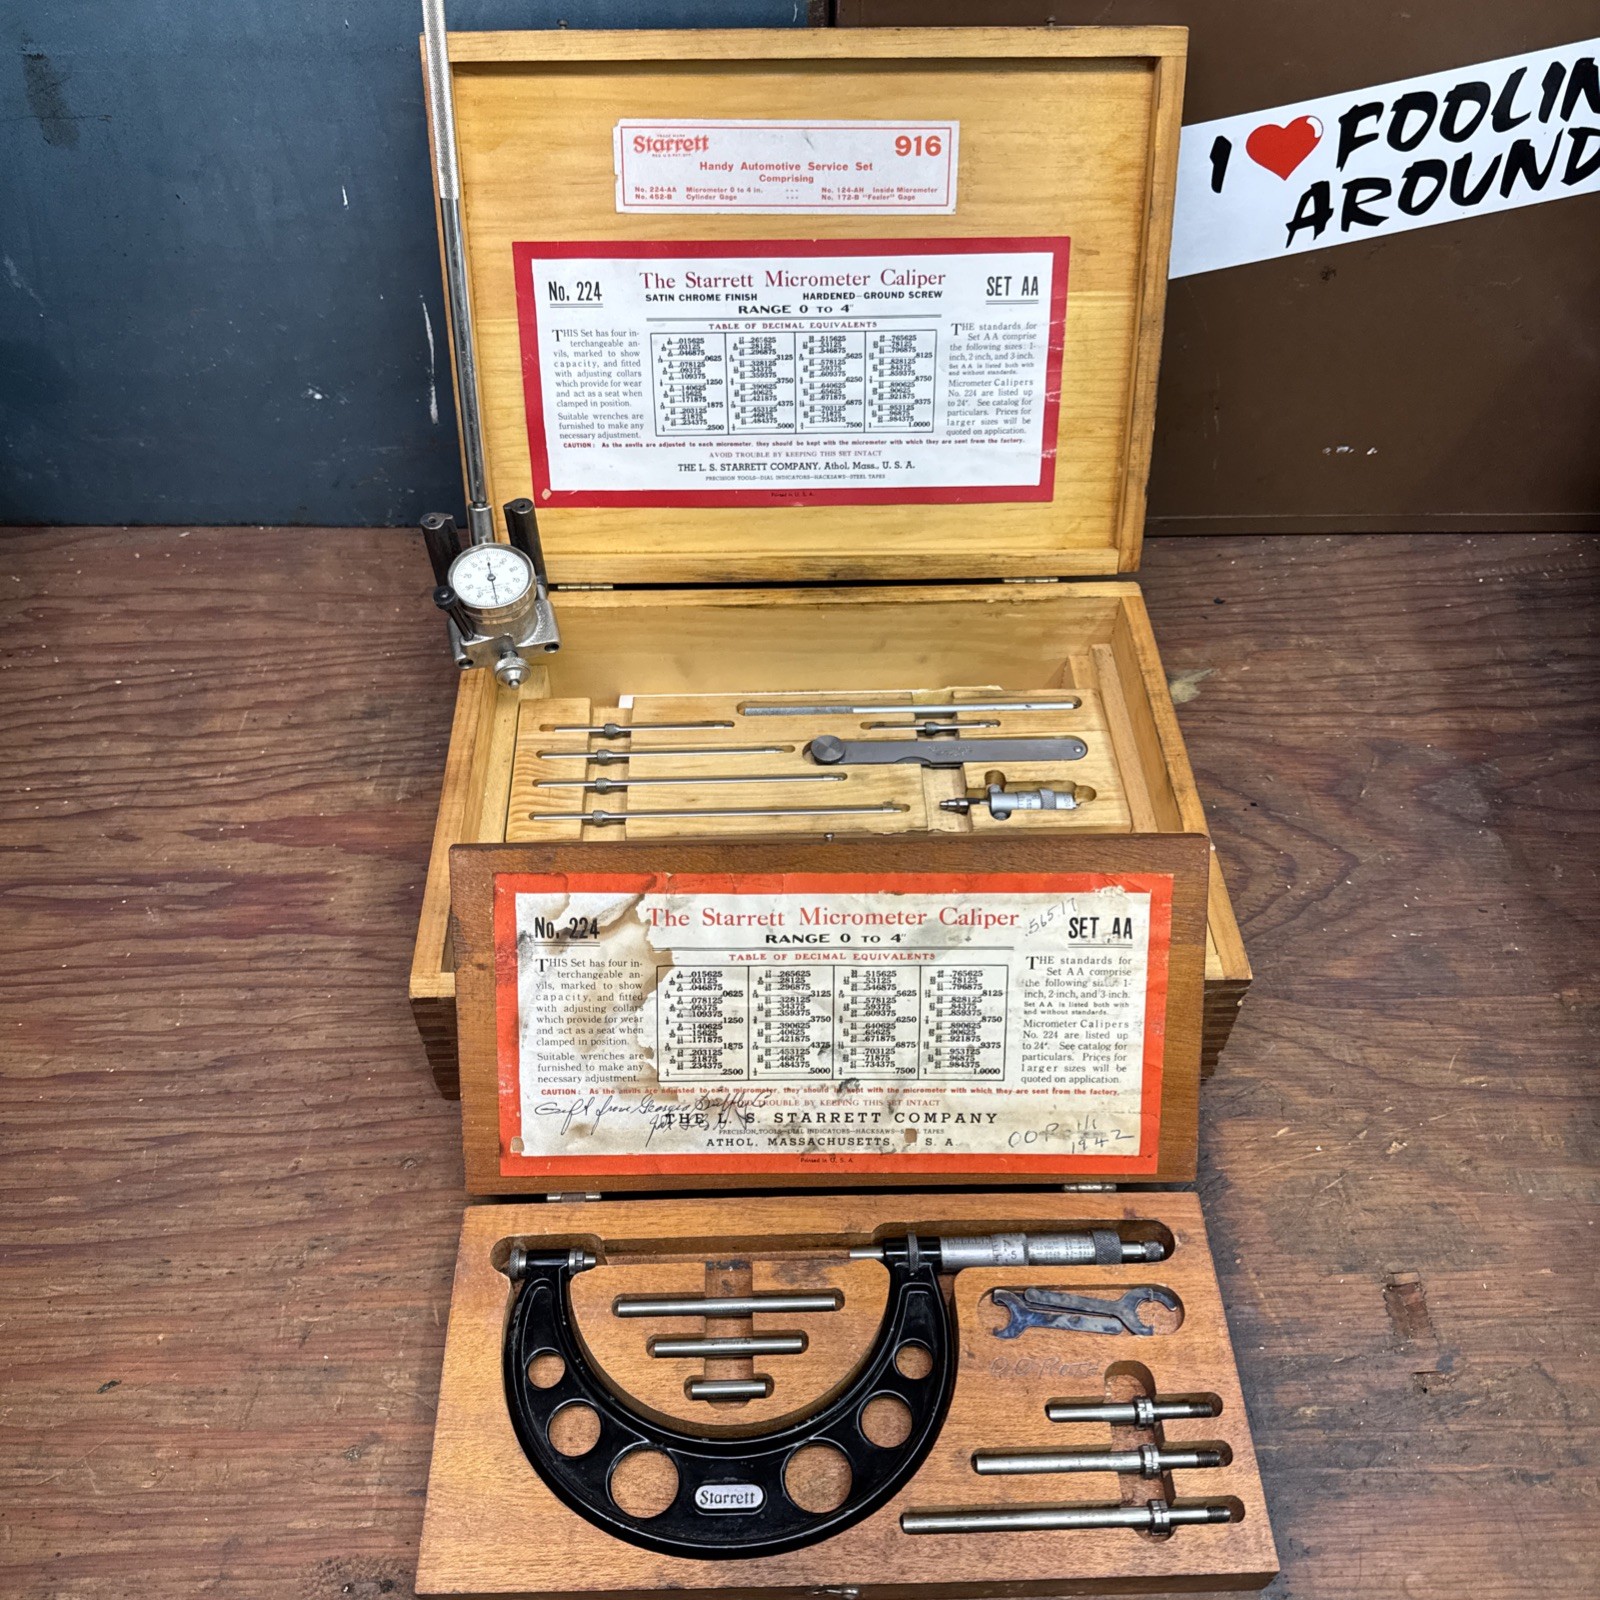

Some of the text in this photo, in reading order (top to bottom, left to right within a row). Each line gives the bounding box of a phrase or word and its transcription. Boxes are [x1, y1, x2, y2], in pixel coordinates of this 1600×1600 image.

[633, 134, 709, 153] Starrett
[895, 135, 942, 156] 916
[700, 161, 872, 172] Handy Automotive Service Set
[1210, 135, 1232, 194] I
[758, 174, 813, 183] Comprising
[1286, 127, 1600, 248] AROUND
[640, 268, 946, 289] The Starrett Micrometer Caliper
[548, 281, 602, 301] No. 224
[986, 275, 1038, 296] SET AA
[738, 304, 790, 314] RANGE
[799, 304, 808, 313] 0
[552, 329, 578, 342] THIS
[581, 328, 592, 336] Set
[596, 328, 609, 336] has
[611, 328, 626, 336] four
[570, 339, 623, 349] terchangeable
[554, 349, 640, 359] vils, marked to show
[554, 359, 640, 369] capacity, and fitted
[555, 369, 641, 379] with adjusting collars
[947, 406, 1031, 417] particulars. Prices for
[947, 416, 1030, 427] larger sizes will be
[946, 426, 971, 437] quoted
[984, 426, 1026, 437] application.
[678, 463, 696, 471] THE
[720, 462, 767, 471] STARRETT
[770, 462, 820, 470] COMPANY,
[882, 461, 891, 469] U.
[646, 907, 1018, 929] The Starrett Micrometer Caliper
[534, 917, 600, 939] No. 224
[1068, 917, 1132, 939] SET AA
[765, 933, 829, 943] RANGE
[840, 933, 850, 942] 0
[852, 952, 935, 960] EQUIVALENTS
[1026, 955, 1131, 970] THE standards for
[1024, 990, 1046, 1000] inch,
[1080, 990, 1097, 998] and
[1023, 1019, 1128, 1030] Micrometer Calipers
[536, 1037, 628, 1048] clamped in position.
[537, 1051, 574, 1060] Suitable
[581, 1051, 624, 1060] wrenches
[538, 1062, 643, 1074] furnished to make any
[538, 1073, 639, 1084] necessary adjustment.
[666, 1112, 704, 1124] THE
[774, 1112, 881, 1123] STARRETT
[894, 1112, 997, 1123] COMPANY
[706, 1138, 758, 1146] ATHOL,
[768, 1137, 894, 1146] MASSACHUSETTS,
[700, 1490, 755, 1504] Starrett
